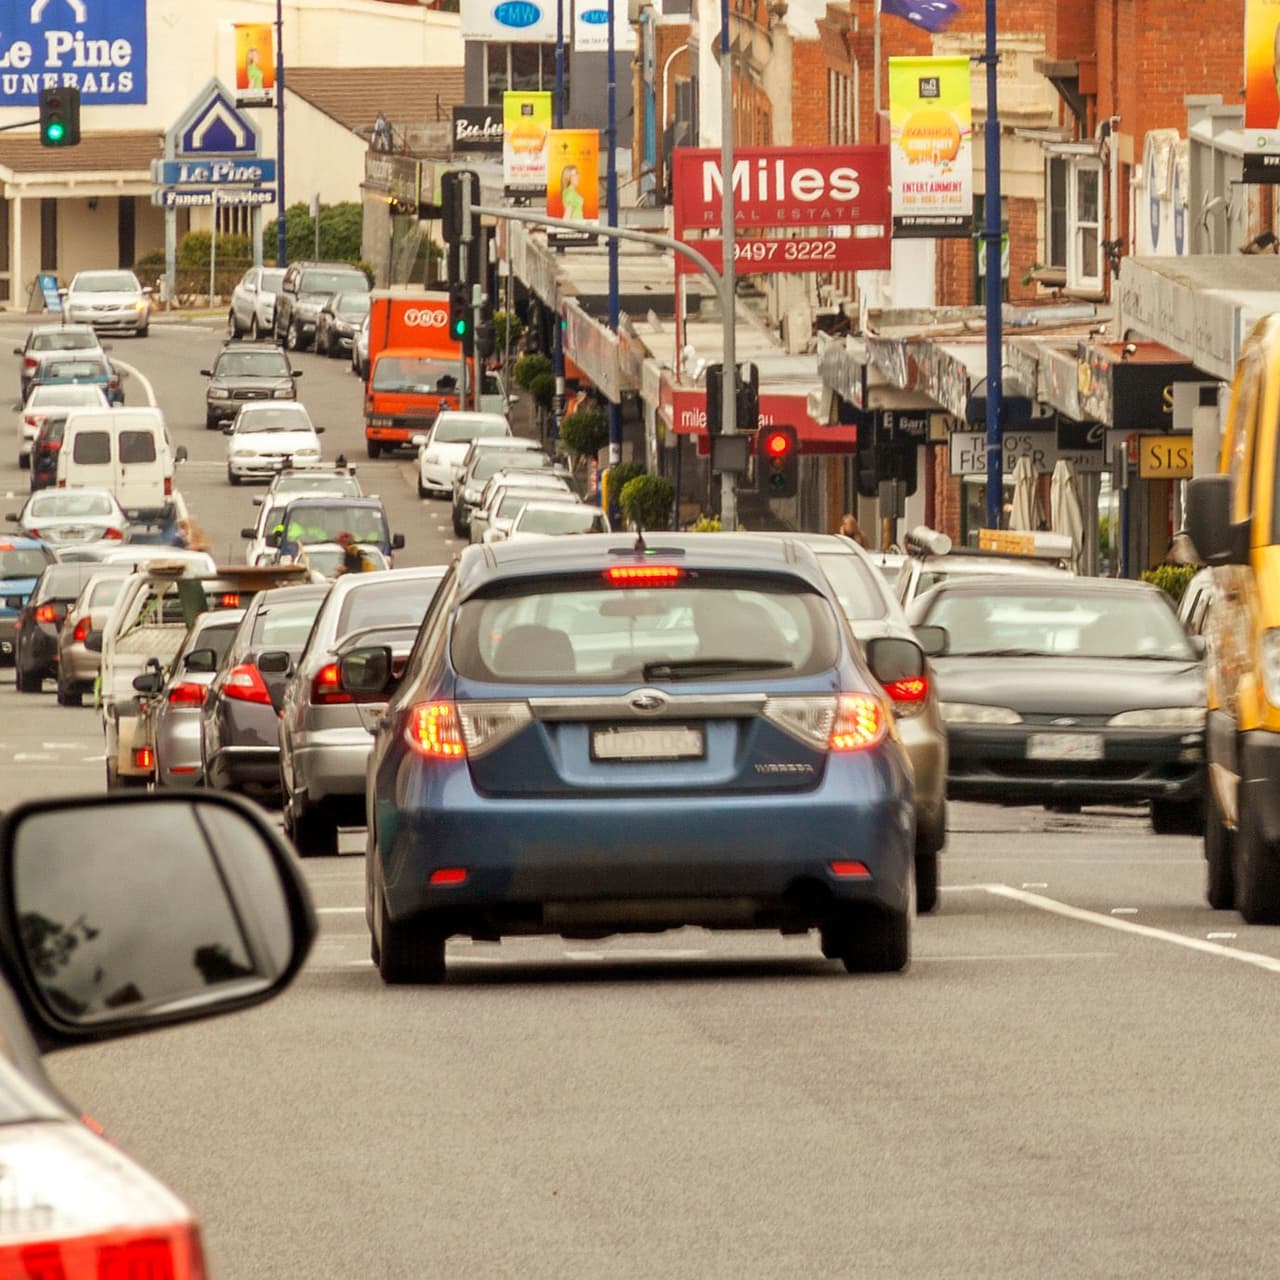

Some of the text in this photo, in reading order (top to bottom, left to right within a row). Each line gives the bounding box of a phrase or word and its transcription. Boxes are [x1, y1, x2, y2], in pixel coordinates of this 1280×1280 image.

[44, 30, 133, 68] Pine
[0, 71, 134, 95] UNERALS
[176, 160, 263, 182] Le Pine
[701, 158, 861, 203] Miles
[165, 192, 215, 206] Funeral
[703, 207, 862, 221] RAL ESTATE
[784, 240, 837, 260] 3222
[404, 308, 448, 328] TNT
[969, 436, 1033, 454] THO'S
[1007, 449, 1046, 470] BR
